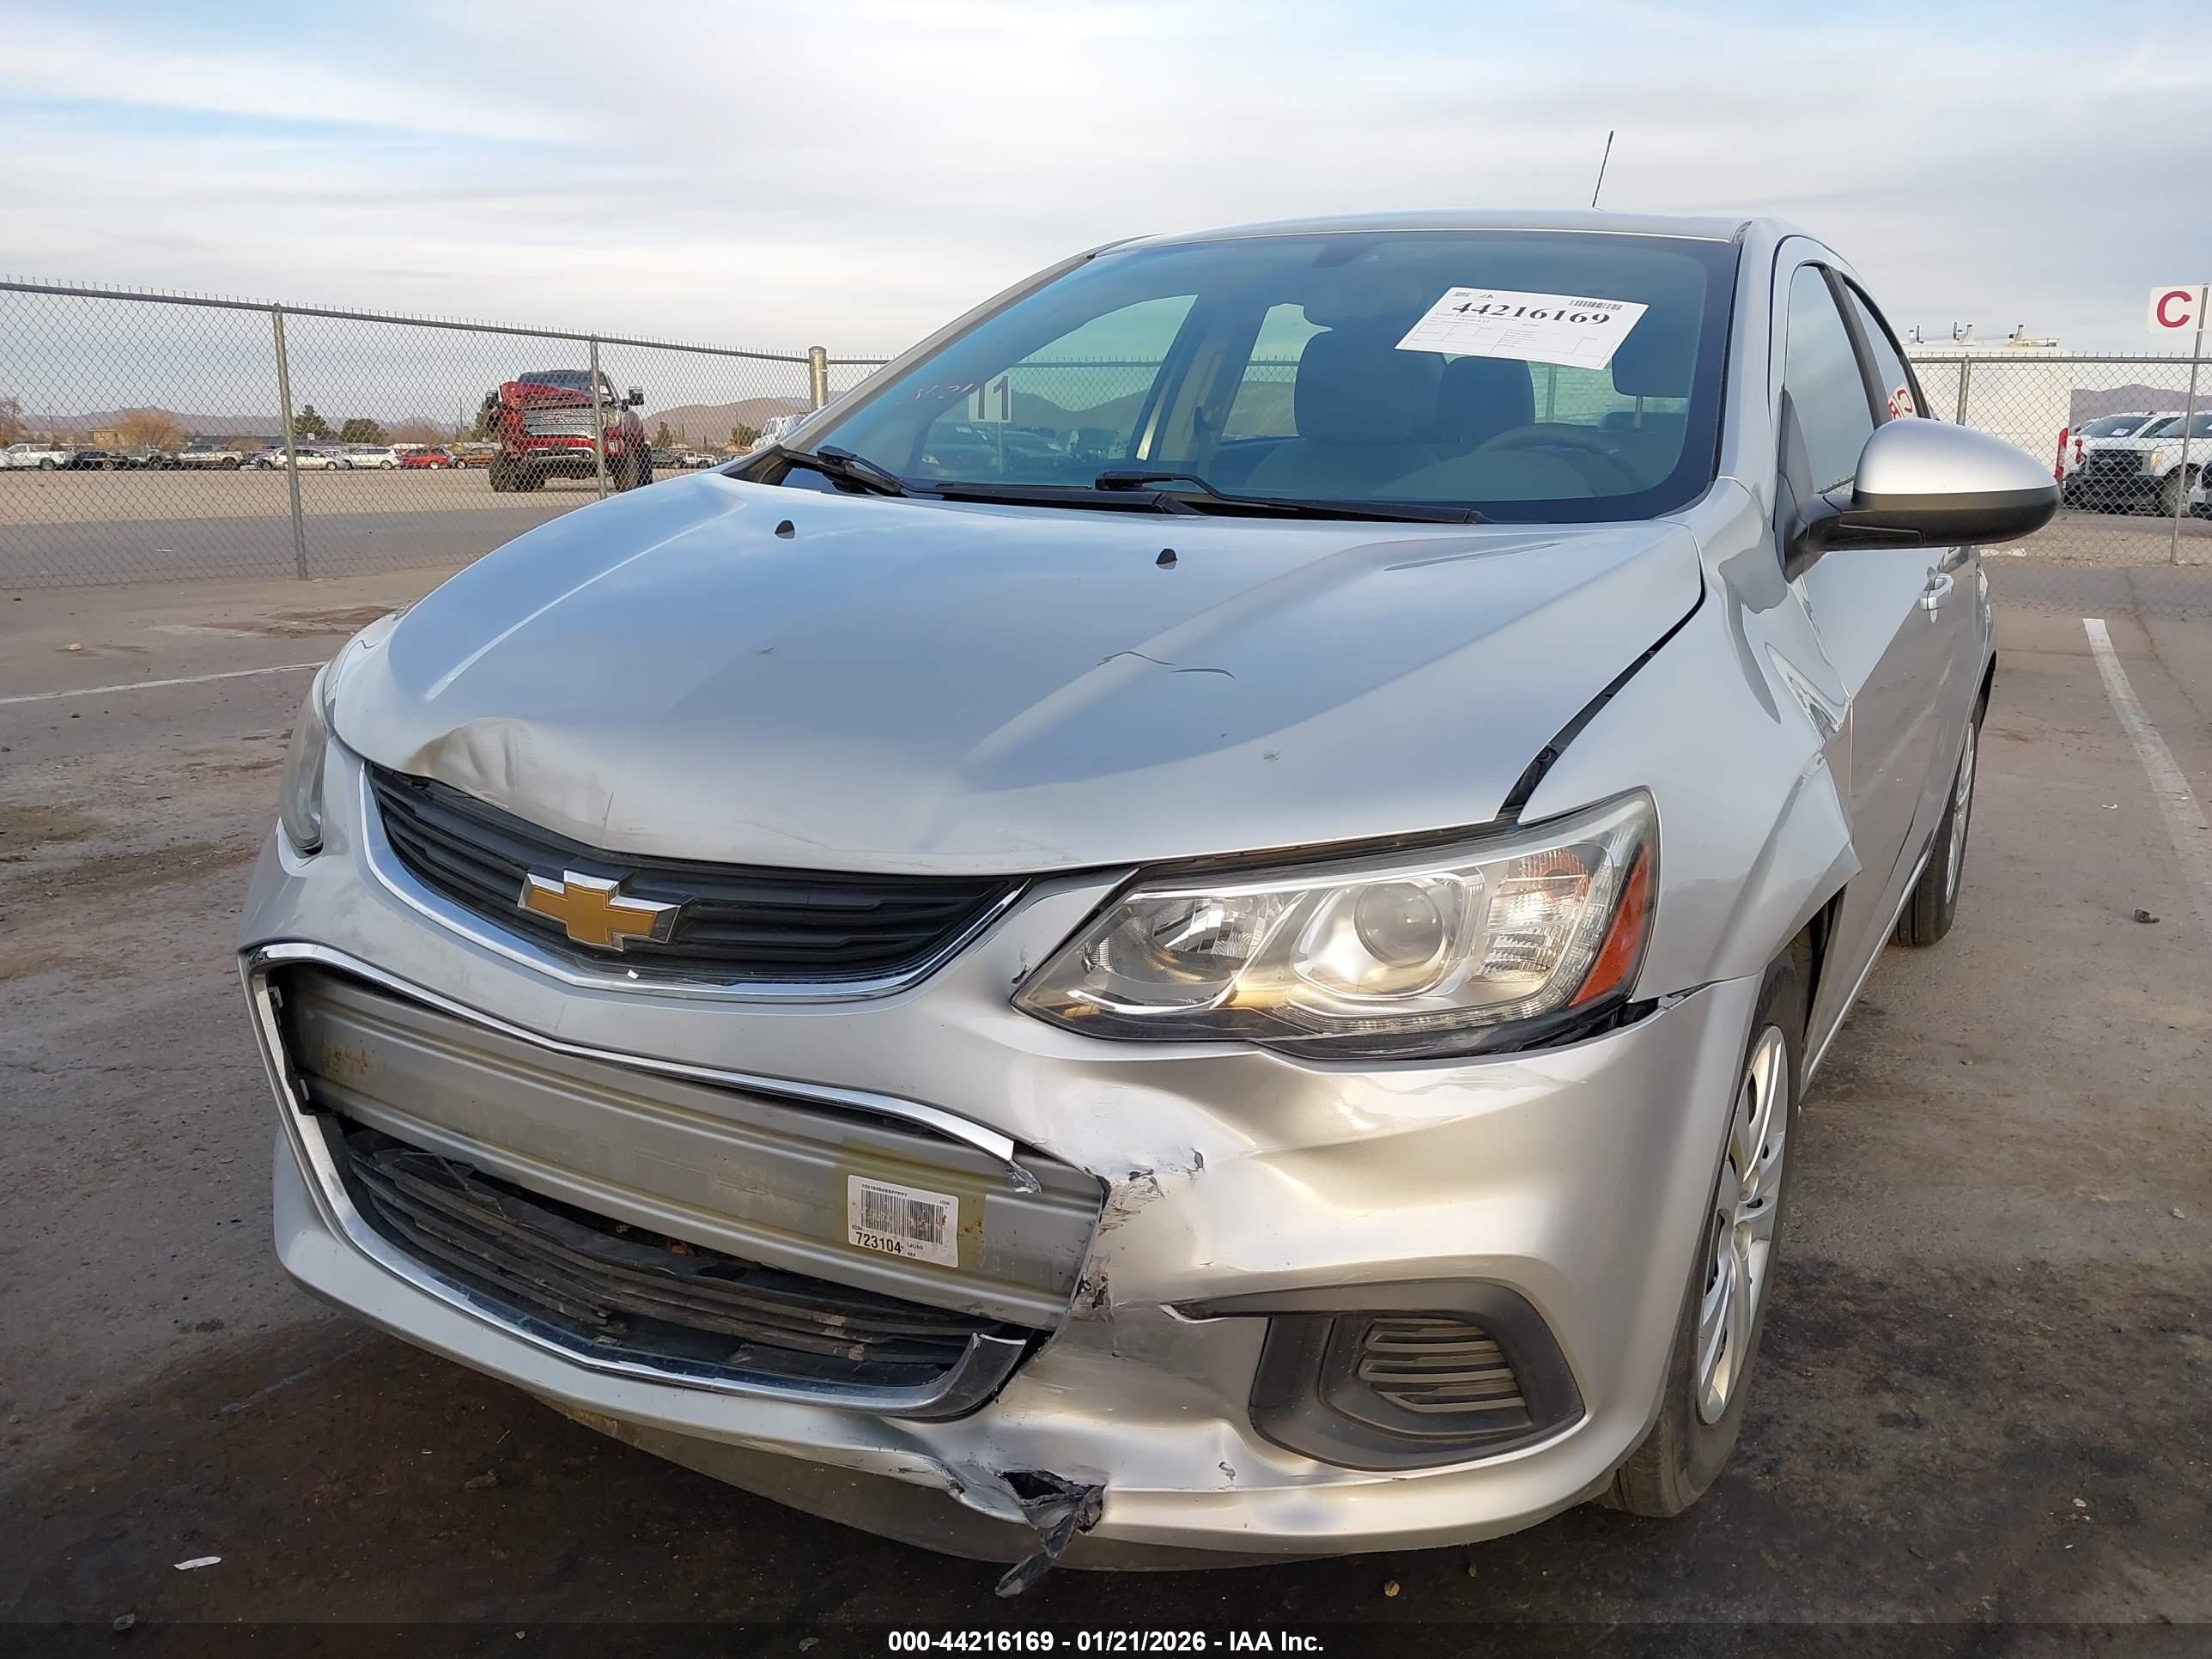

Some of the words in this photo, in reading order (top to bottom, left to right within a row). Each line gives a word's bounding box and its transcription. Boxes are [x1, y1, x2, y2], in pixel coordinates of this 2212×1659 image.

[1452, 301, 1611, 325] 44216169
[2156, 290, 2192, 328] C
[855, 1231, 902, 1254] 723104
